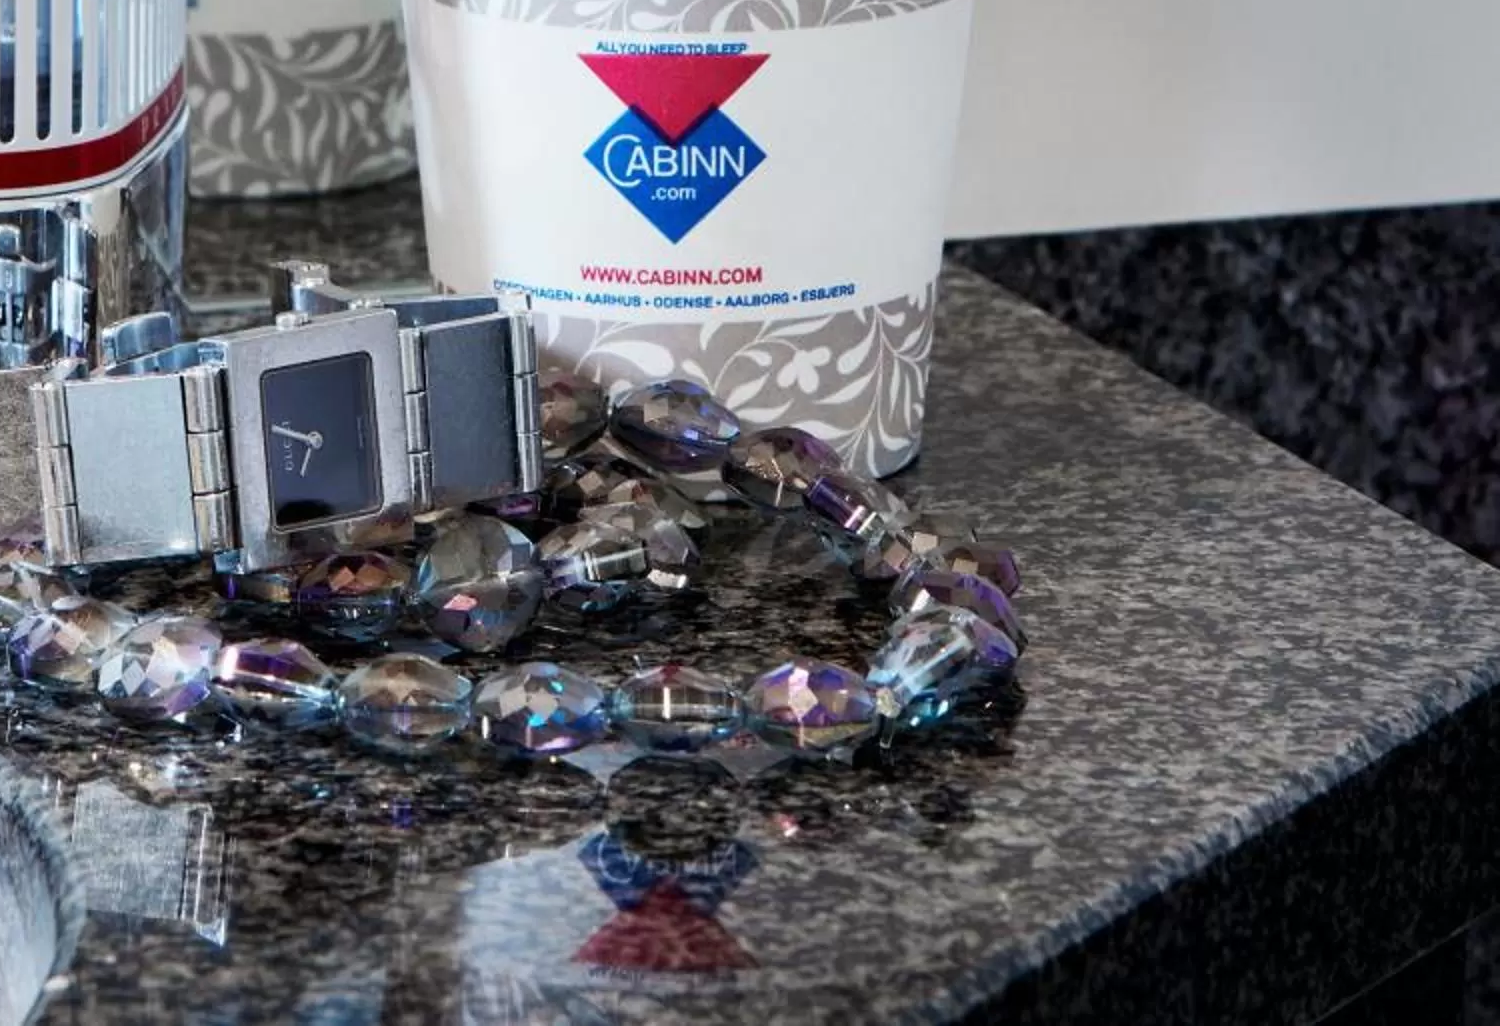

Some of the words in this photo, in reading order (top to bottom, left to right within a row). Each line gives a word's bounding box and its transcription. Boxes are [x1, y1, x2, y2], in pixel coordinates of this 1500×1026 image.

[596, 41, 618, 53] ALL
[619, 42, 647, 55] YOU
[649, 43, 685, 56] NEED
[687, 43, 704, 56] TO
[705, 42, 748, 56] SLEEP
[603, 133, 746, 189] CABINN
[650, 186, 697, 202] .com
[580, 265, 763, 286] WWW.CABINN.COM
[584, 292, 641, 308] AARHUS
[653, 295, 714, 309] ODENSE
[723, 291, 790, 308] AALBORG
[800, 282, 856, 302] ESBJERG
